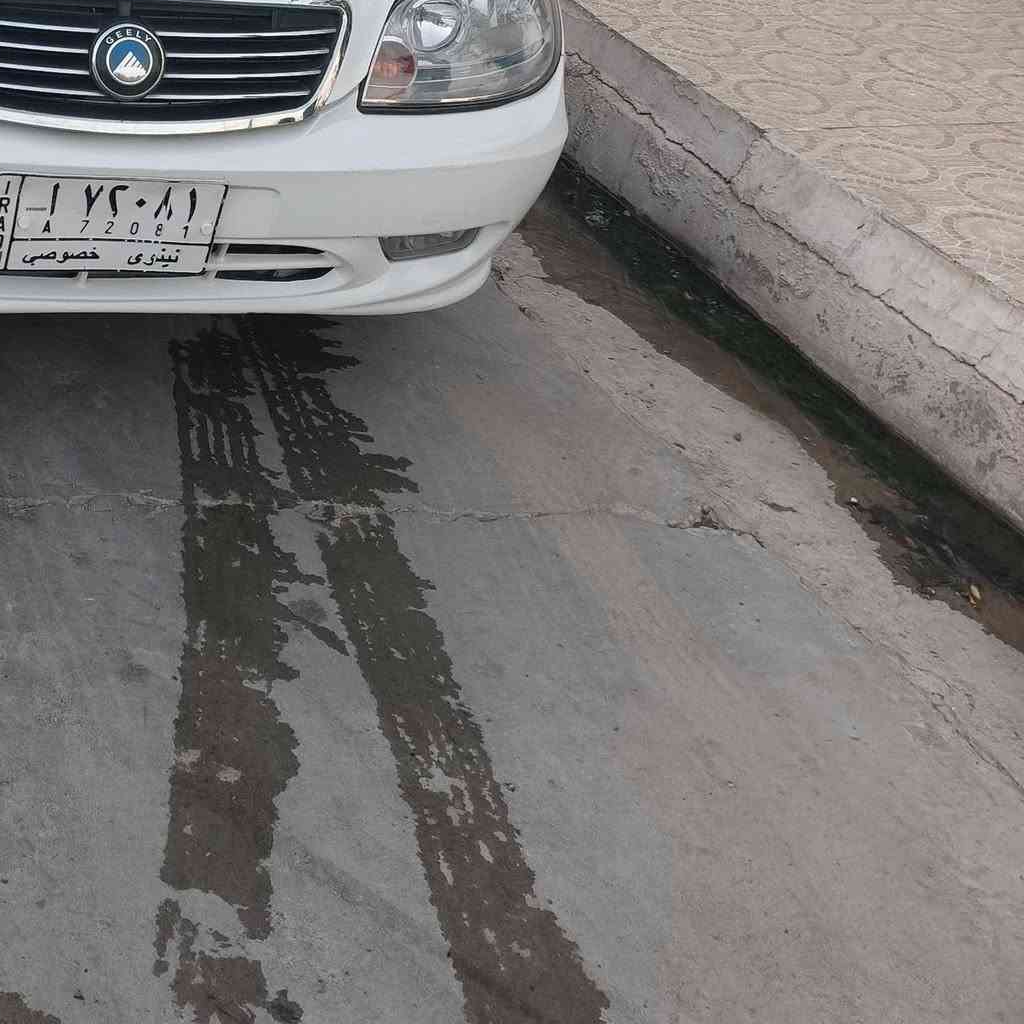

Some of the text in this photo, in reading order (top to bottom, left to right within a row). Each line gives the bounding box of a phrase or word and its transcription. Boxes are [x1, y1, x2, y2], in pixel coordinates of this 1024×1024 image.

[105, 28, 152, 45] GEELY
[42, 219, 52, 234] A
[22, 247, 101, 266] خصوصي
